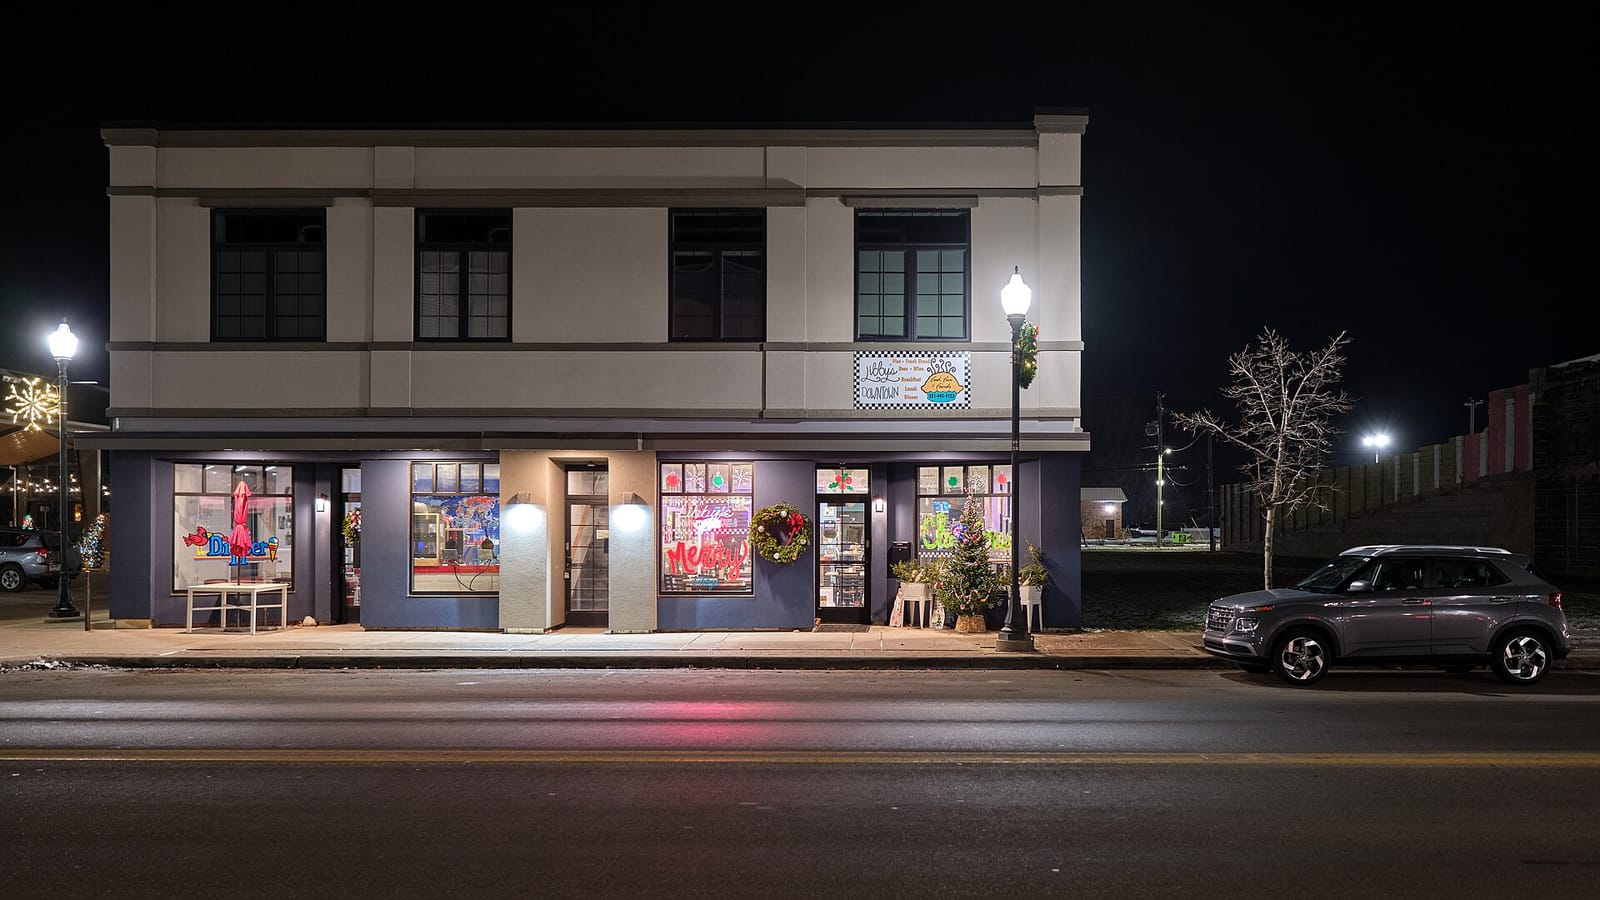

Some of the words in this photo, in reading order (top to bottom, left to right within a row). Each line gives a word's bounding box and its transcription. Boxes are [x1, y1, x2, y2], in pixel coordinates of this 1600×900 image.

[861, 361, 900, 383] Libby's
[861, 386, 899, 400] DOWNTOWN
[207, 535, 268, 566] Dier
[667, 540, 748, 581] Merry
